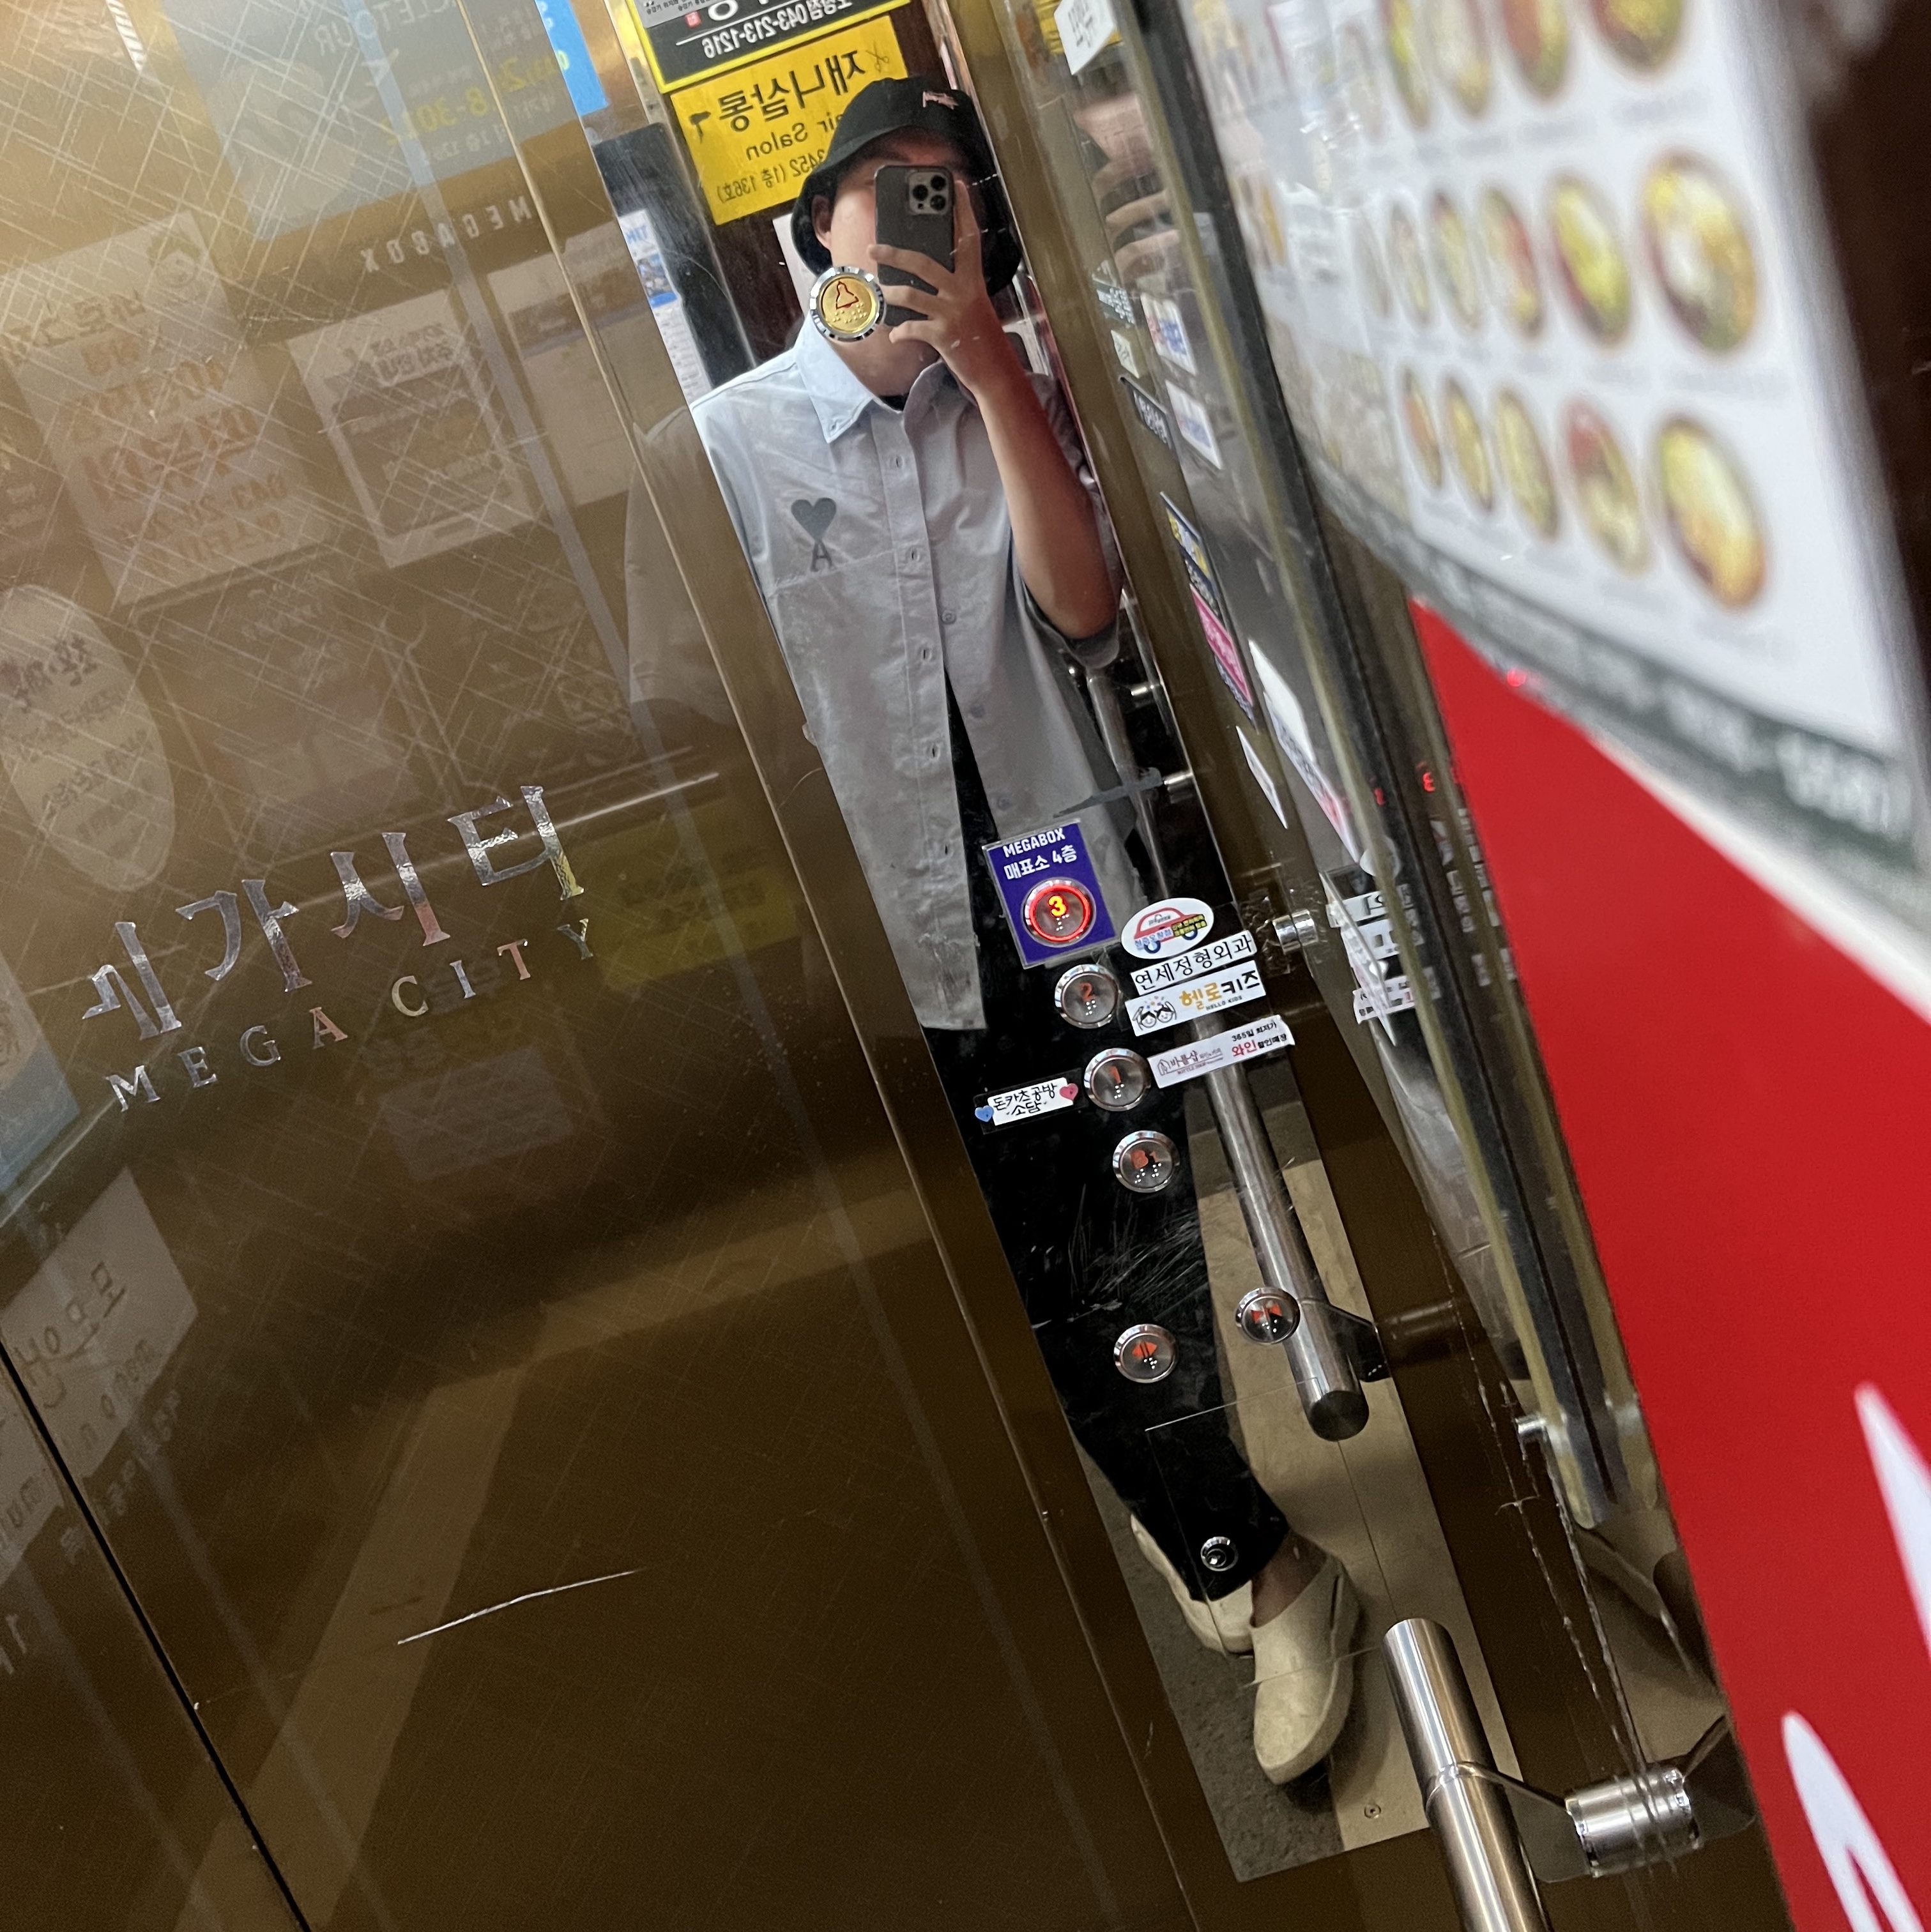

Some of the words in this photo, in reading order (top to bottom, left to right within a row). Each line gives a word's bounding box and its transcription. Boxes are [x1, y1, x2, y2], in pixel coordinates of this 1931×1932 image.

[1002, 827, 1066, 858] MEGABOX
[1004, 855, 1050, 880] 매표소
[1052, 844, 1077, 863] 4층
[1048, 895, 1067, 917] 3
[1135, 934, 1252, 991] 연세정형외과
[1080, 982, 1095, 1002] 2
[1179, 970, 1260, 1010] 헬로키즈
[105, 1007, 348, 1113] MEGA
[391, 918, 594, 1017] CITY
[1232, 1040, 1257, 1057] 와인
[1110, 1065, 1122, 1084] 1
[1011, 1101, 1041, 1116] 소담
